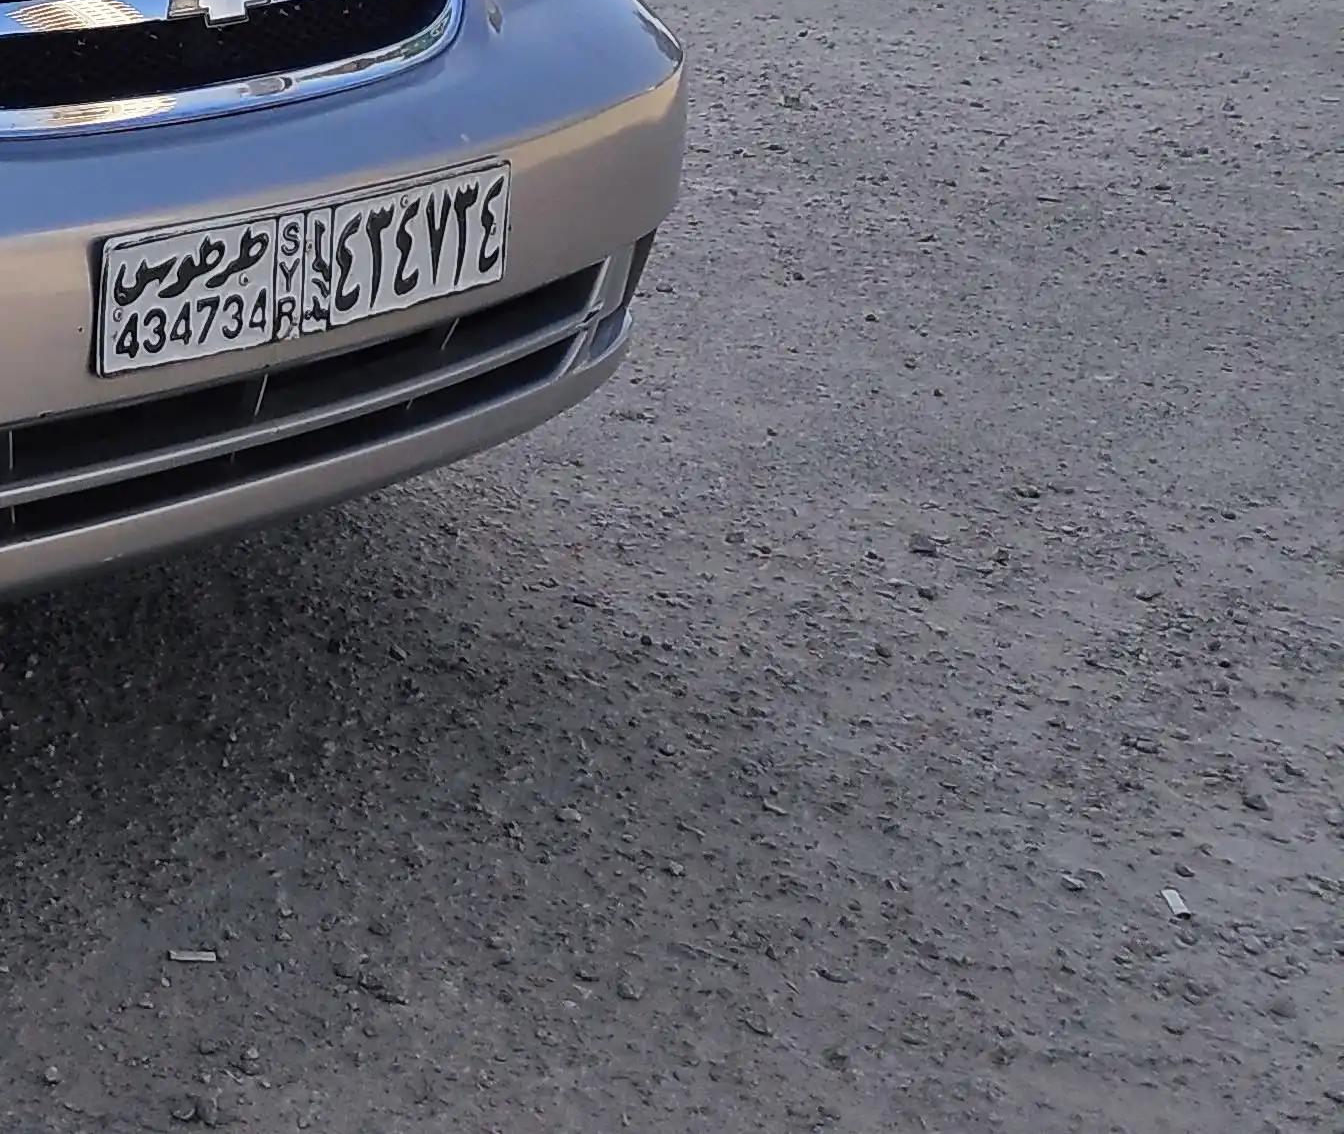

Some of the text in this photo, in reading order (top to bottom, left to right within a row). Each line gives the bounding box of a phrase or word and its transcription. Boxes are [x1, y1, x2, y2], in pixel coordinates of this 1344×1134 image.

[113, 227, 269, 307] طرطوس
[335, 175, 505, 313] ٤٣٤٧٣٤
[115, 288, 268, 359] 434734
